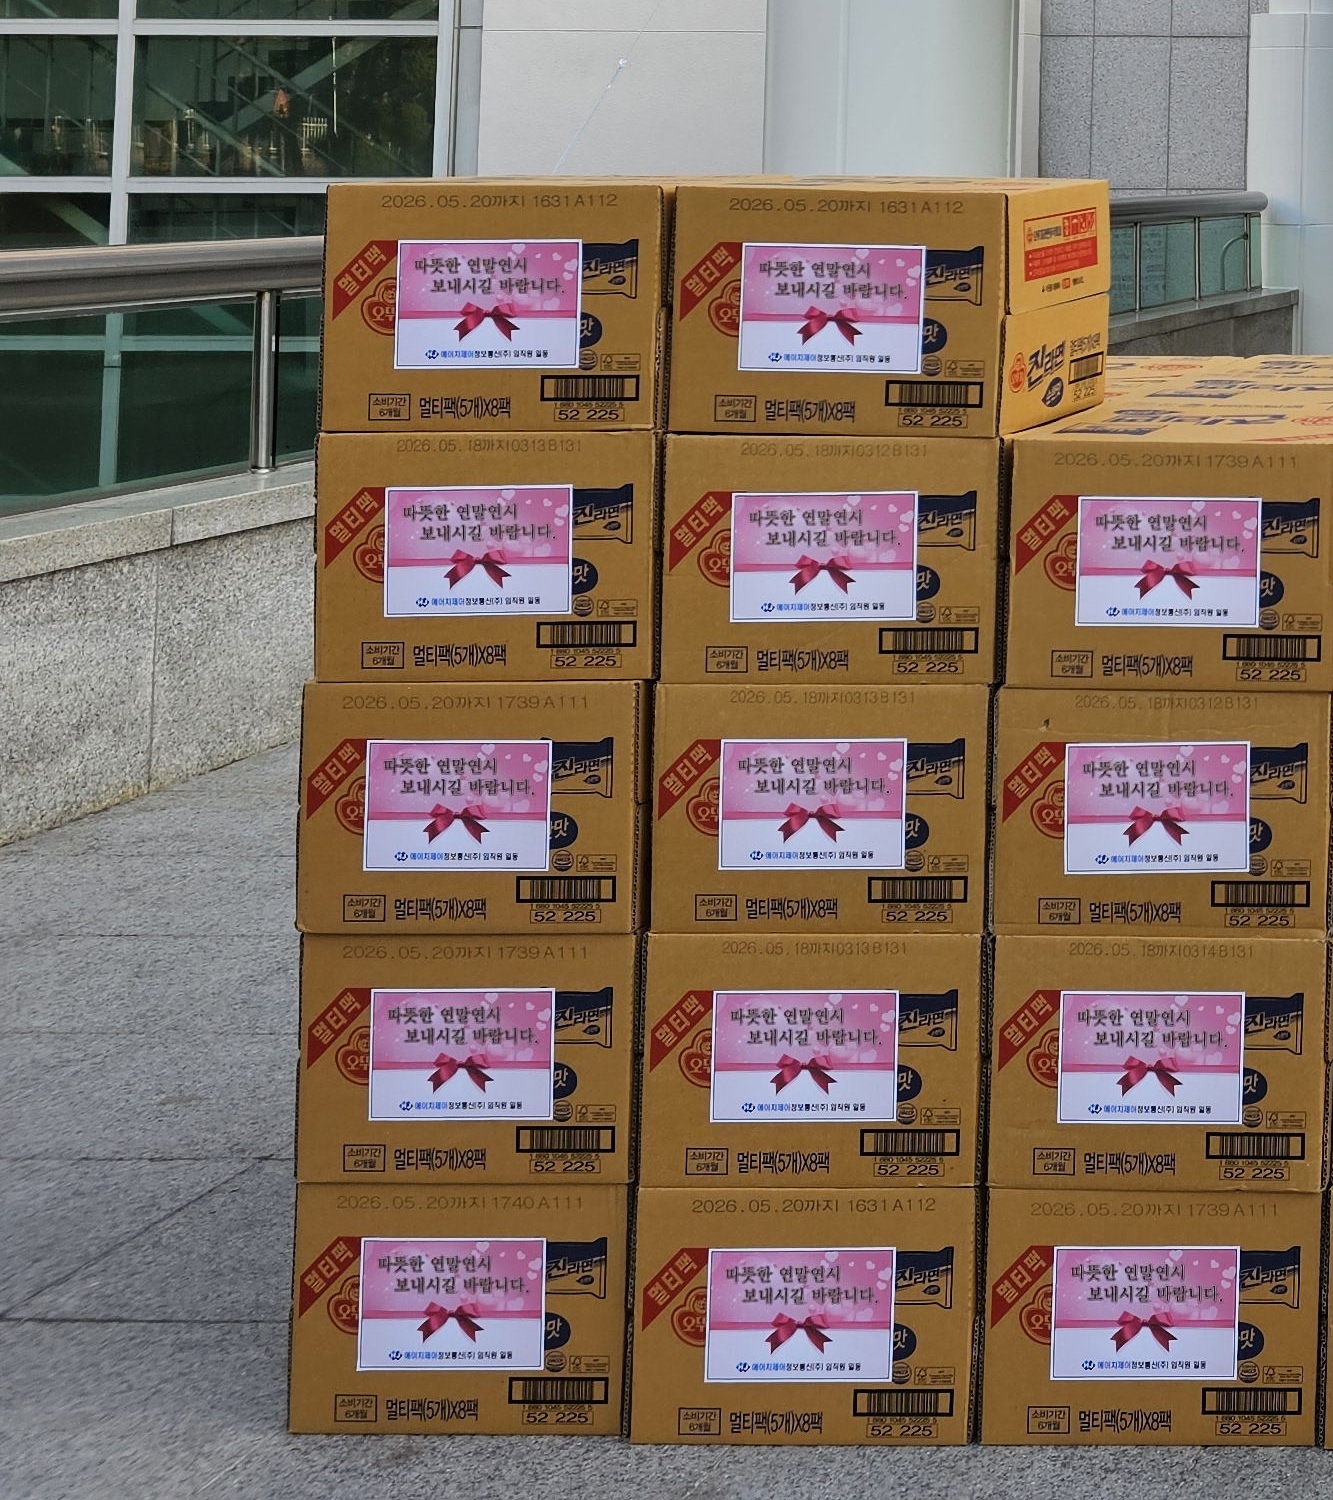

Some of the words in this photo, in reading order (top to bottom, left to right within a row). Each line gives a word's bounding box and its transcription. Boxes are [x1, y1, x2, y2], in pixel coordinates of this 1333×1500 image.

[337, 244, 387, 296] 멀티팩
[414, 257, 461, 273] 따뜻한
[467, 256, 528, 273] 연말연시
[430, 277, 495, 295] 보내시길
[499, 277, 566, 295] 바랍니다.
[513, 349, 533, 359] 임직원
[535, 349, 549, 359] 일동
[1027, 339, 1067, 392] 진라면
[371, 396, 407, 406] 소비기간
[379, 407, 402, 418] 6개월
[558, 409, 580, 420] 52
[586, 409, 620, 420] 225
[378, 1256, 424, 1273] 따뜻한
[430, 1255, 491, 1273] 연말연시
[393, 1277, 456, 1295] 보내시길
[463, 1276, 530, 1295] 바랍니다.
